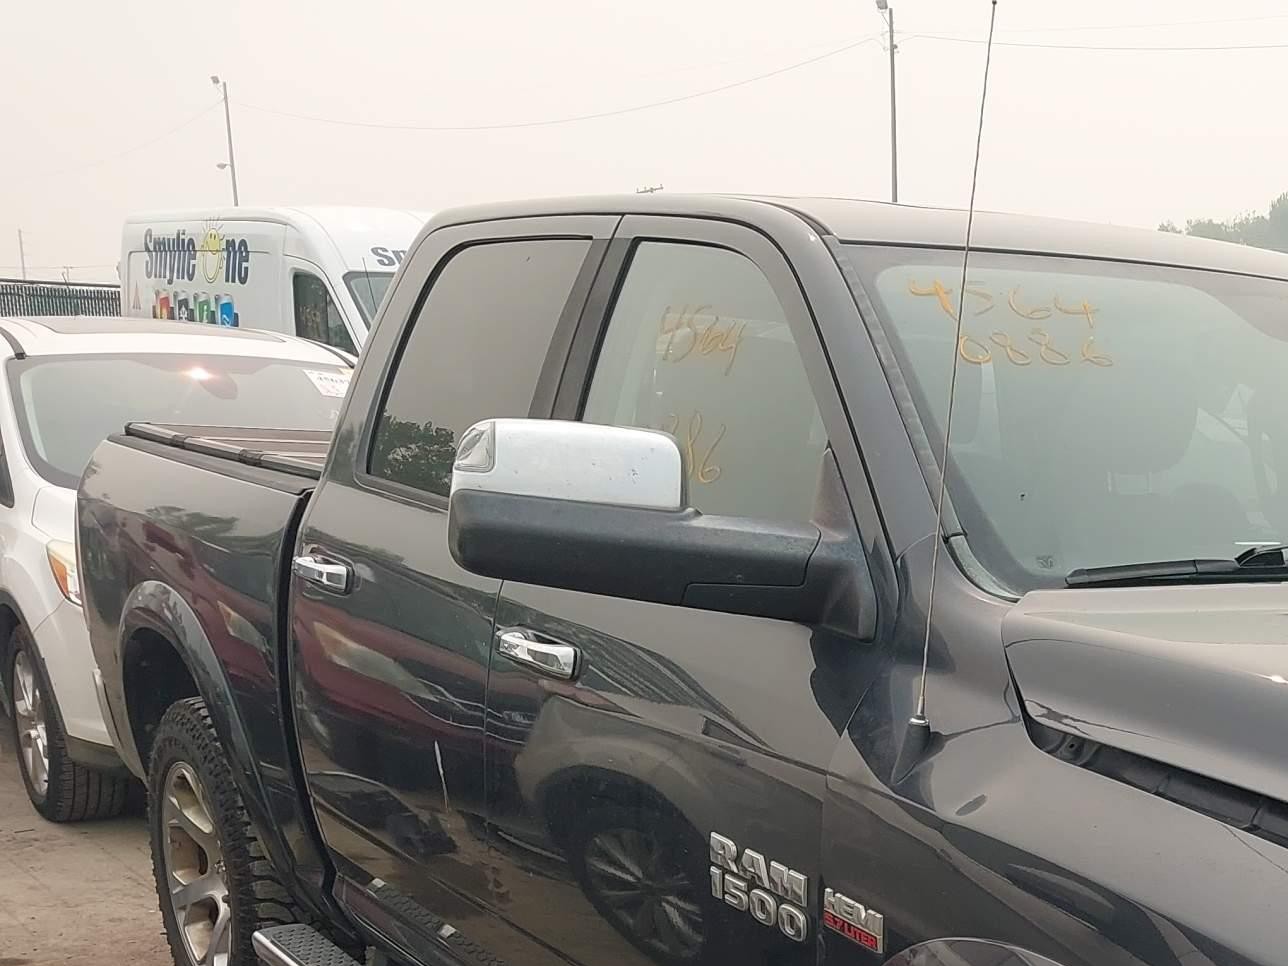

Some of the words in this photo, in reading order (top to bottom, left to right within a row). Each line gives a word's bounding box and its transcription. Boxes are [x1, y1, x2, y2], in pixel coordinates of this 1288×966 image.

[144, 228, 197, 285] Smylie
[710, 831, 808, 908] RAM
[710, 865, 808, 943] 1500
